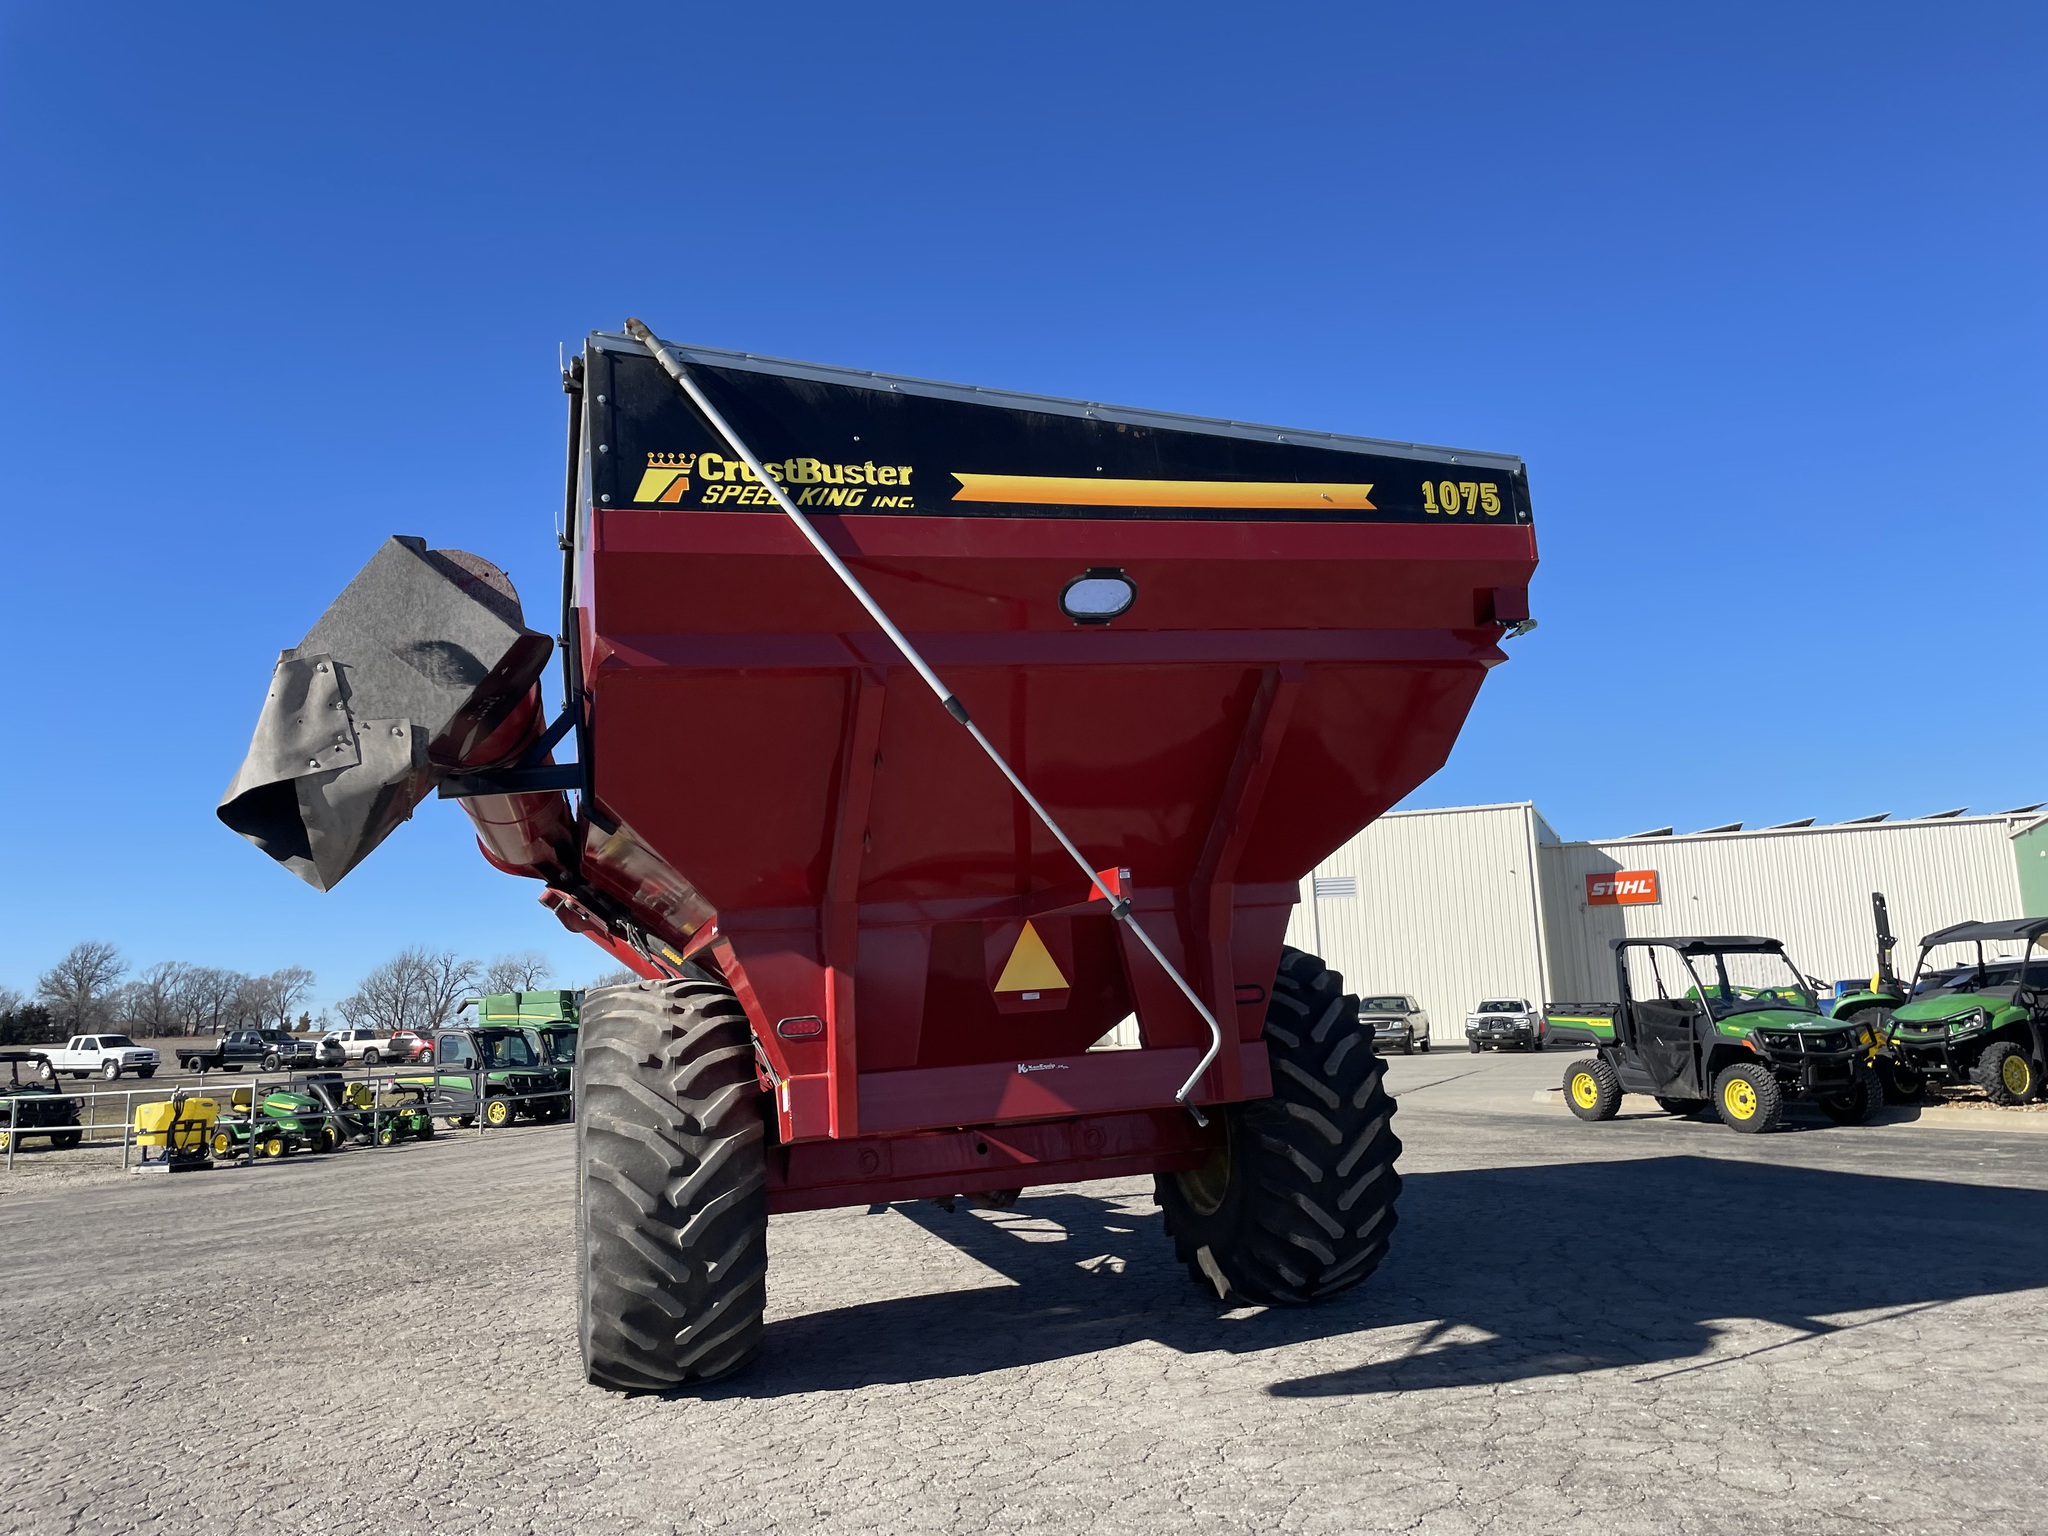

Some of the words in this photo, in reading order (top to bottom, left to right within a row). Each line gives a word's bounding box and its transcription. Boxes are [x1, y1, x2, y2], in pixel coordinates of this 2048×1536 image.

[698, 452, 913, 485] CrustBuster
[797, 487, 867, 506] KING
[871, 496, 915, 508] INC.
[1421, 480, 1501, 516] 1075
[1591, 880, 1652, 896] STIHL
